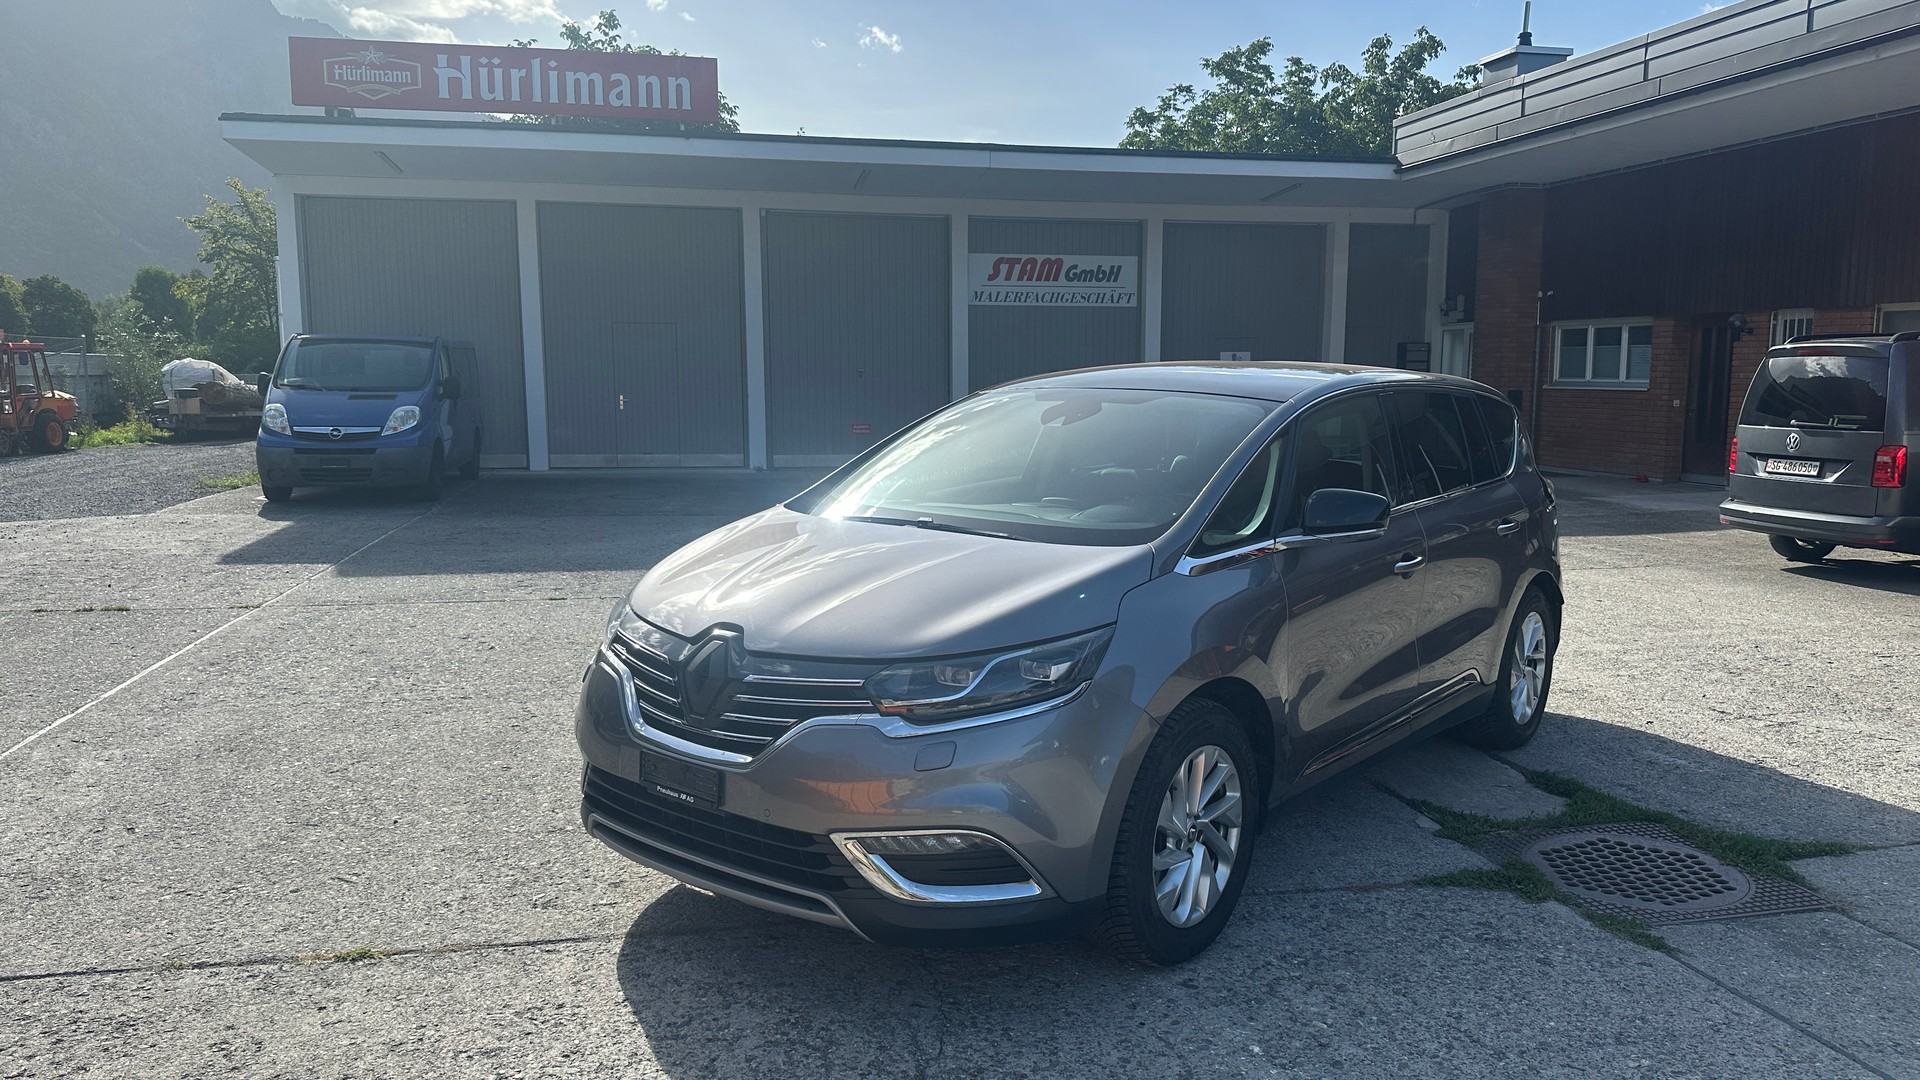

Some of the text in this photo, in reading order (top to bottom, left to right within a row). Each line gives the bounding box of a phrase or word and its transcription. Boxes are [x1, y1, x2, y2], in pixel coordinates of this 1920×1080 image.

[333, 64, 411, 83] Hürlimann
[433, 54, 692, 110] Hürlimann
[987, 257, 1122, 283] STAM GmbH
[972, 289, 1135, 305] MALERFACHGESCHÄFT
